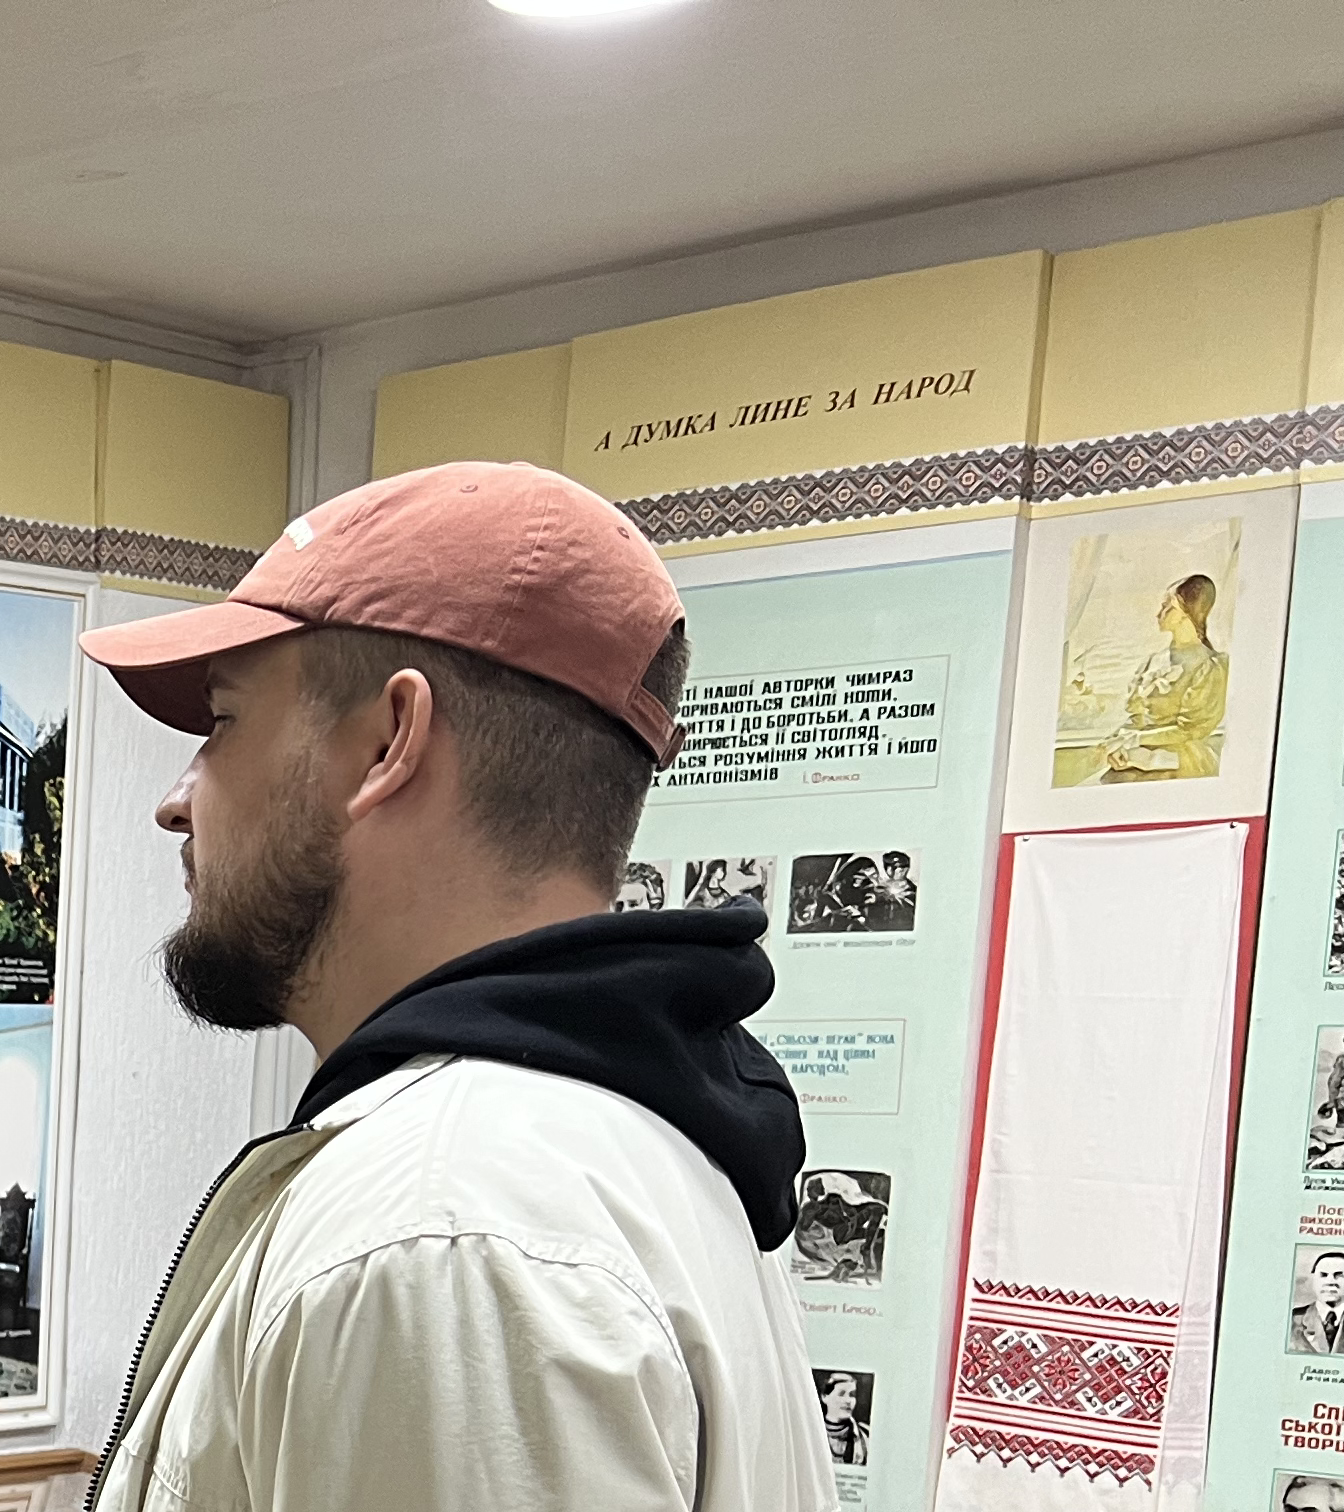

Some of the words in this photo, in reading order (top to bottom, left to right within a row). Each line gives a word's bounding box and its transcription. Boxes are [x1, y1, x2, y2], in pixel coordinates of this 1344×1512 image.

[594, 431, 611, 452] А
[621, 412, 717, 450] ДУМКА
[729, 395, 812, 429] ЛИНЕ
[825, 388, 856, 413] ЗА
[872, 368, 978, 406] НАРОД
[683, 685, 697, 701] ТІ
[704, 679, 754, 700] НАШОЇ
[761, 676, 836, 695] АВТОРКИ
[846, 669, 914, 687] ЧИМРАЗ
[678, 697, 783, 718] ОРИВАЮТЬСЯ
[790, 689, 837, 709] СМІЛІ
[684, 719, 725, 734] ИТТЯ
[740, 716, 762, 734] ДО
[859, 707, 870, 722] А
[877, 703, 935, 720] РАЗОМ
[682, 733, 769, 751] ШИРЮЄТЬСЯ
[714, 747, 807, 767] РОЗУМІННЯ
[815, 743, 878, 760] ЖИТТЯ
[897, 737, 937, 754] ЙОГО
[667, 765, 779, 787] АНТАГОНІЗМІВ
[1299, 1225, 1344, 1236] РАДЯН
[1300, 1215, 1344, 1226] ВИХОВ
